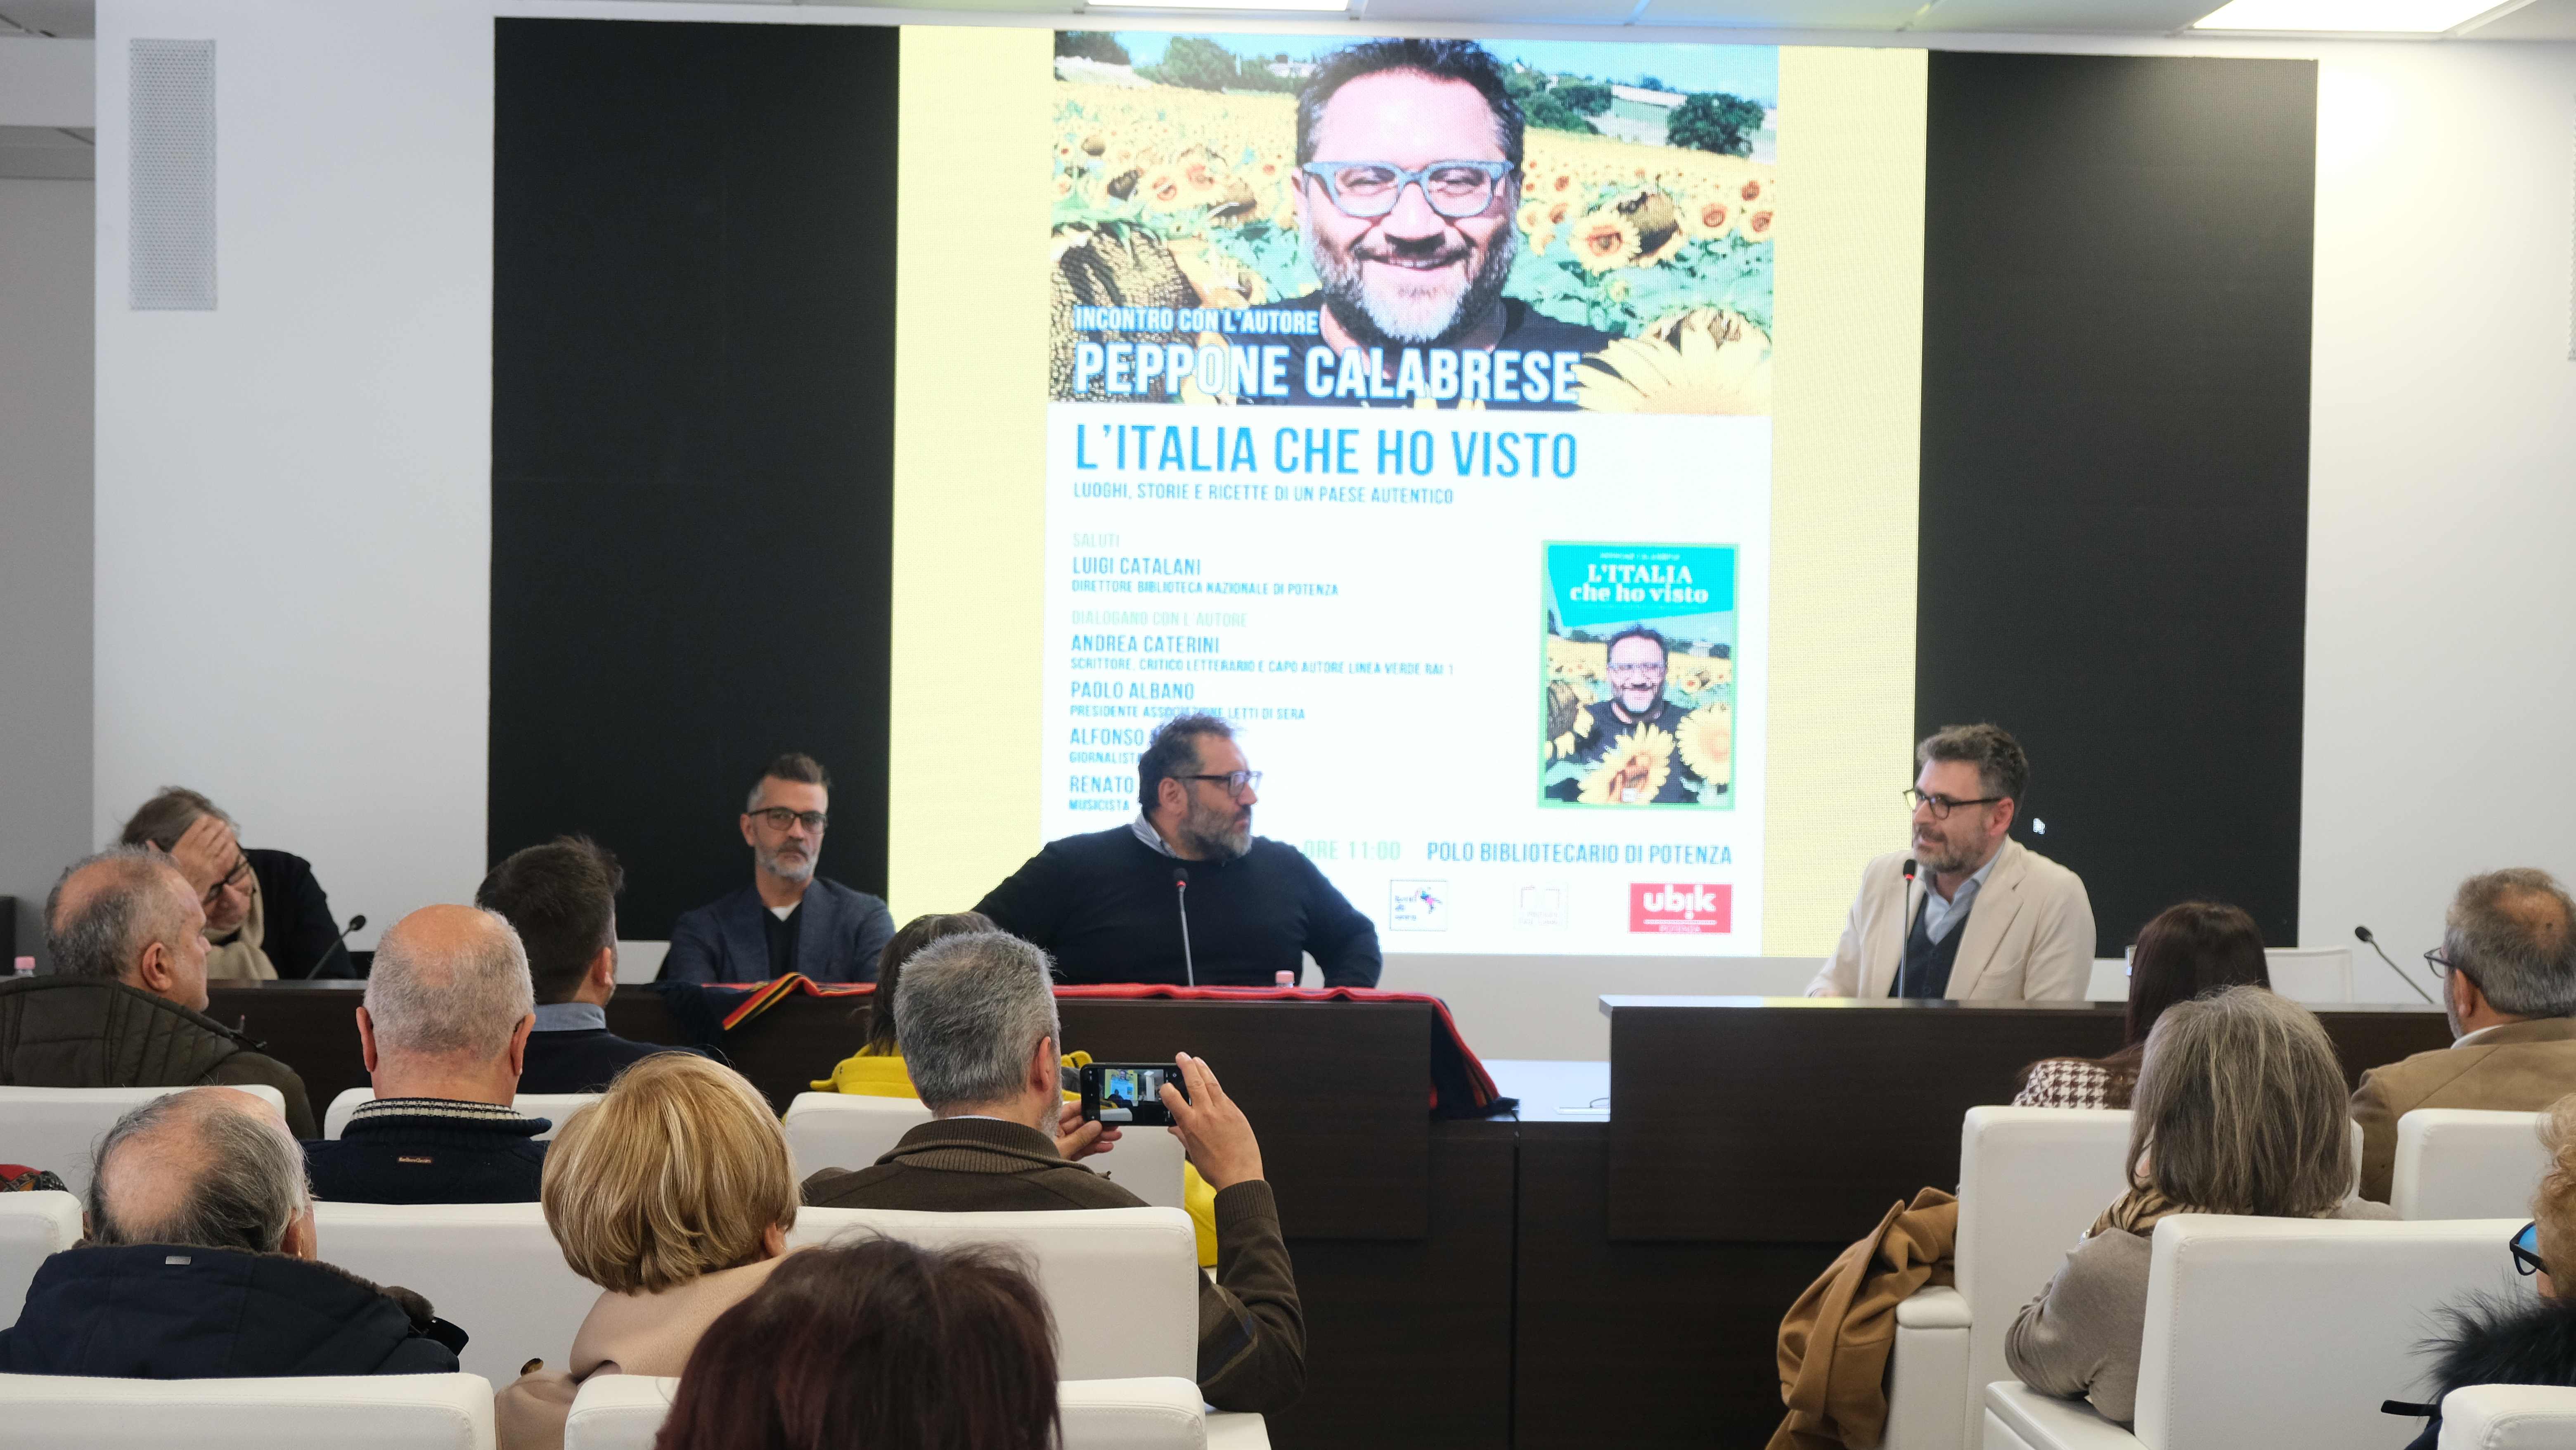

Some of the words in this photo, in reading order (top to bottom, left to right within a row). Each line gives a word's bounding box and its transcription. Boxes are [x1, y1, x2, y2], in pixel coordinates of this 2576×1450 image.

[1075, 306, 1174, 332] INCONTRO
[1179, 308, 1220, 334] CON
[1224, 310, 1319, 335] L'AUTORE
[1075, 343, 1290, 397] PEPPONE
[1304, 346, 1582, 403] CALABRESE
[1077, 424, 1257, 472] L'ITALIA
[1275, 427, 1359, 474] CHE
[1378, 429, 1434, 476] HO
[1451, 431, 1577, 479] VISTO
[1074, 482, 1132, 499] LUOGHI,
[1137, 482, 1189, 500] STORIE
[1194, 483, 1202, 500] E
[1209, 484, 1268, 500] RICETTE
[1274, 485, 1289, 501] DI
[1294, 486, 1314, 502] UN
[1319, 486, 1365, 502] PAESE
[1371, 487, 1454, 505] AUTENTICO
[1073, 532, 1120, 548] SALUTI
[1073, 557, 1114, 575] LUIGI
[1120, 557, 1200, 576] CATALANI
[1589, 564, 1693, 584] L'ITALIA
[1072, 579, 1132, 592] DIRETTORE
[1137, 581, 1203, 594] BIBLIOTECA
[1206, 582, 1267, 595] NAZIONALE
[1273, 583, 1285, 595] DI
[1288, 583, 1338, 596] POTENZA
[1570, 582, 1610, 602] che
[1616, 583, 1645, 602] ho
[1649, 583, 1709, 603] visto
[1153, 611, 1180, 626] CON
[1183, 611, 1248, 628] L'AUTORE
[1071, 634, 1137, 652] ANDREA
[1144, 635, 1219, 654] CATERINI
[1139, 658, 1184, 671] CRITICO
[1186, 659, 1255, 672] LETTERARIO
[1258, 660, 1264, 673] E
[1269, 661, 1298, 673] CAPO
[1301, 661, 1344, 673] AUTORE
[1349, 662, 1381, 674] LINEA
[1384, 662, 1420, 675] VERDE
[1071, 680, 1123, 699] PAOLO
[1129, 682, 1194, 700] ALBANO
[1070, 705, 1137, 717] PRESIDENTE
[1227, 707, 1259, 719] LETTI
[1261, 707, 1274, 720] DI
[1276, 707, 1305, 720] SERA
[1070, 727, 1144, 746] ALFONSO
[1070, 775, 1134, 794] RENATO
[1068, 798, 1129, 811] MUSICISTA
[1304, 839, 1339, 860] ORE
[1349, 840, 1401, 861] 11:00
[1427, 841, 1475, 862] POLO
[1480, 842, 1619, 863] BIBLIOTECARIO
[1625, 844, 1643, 864] DI
[1649, 844, 1732, 865] POTENZA
[1643, 884, 1716, 919] ubik
